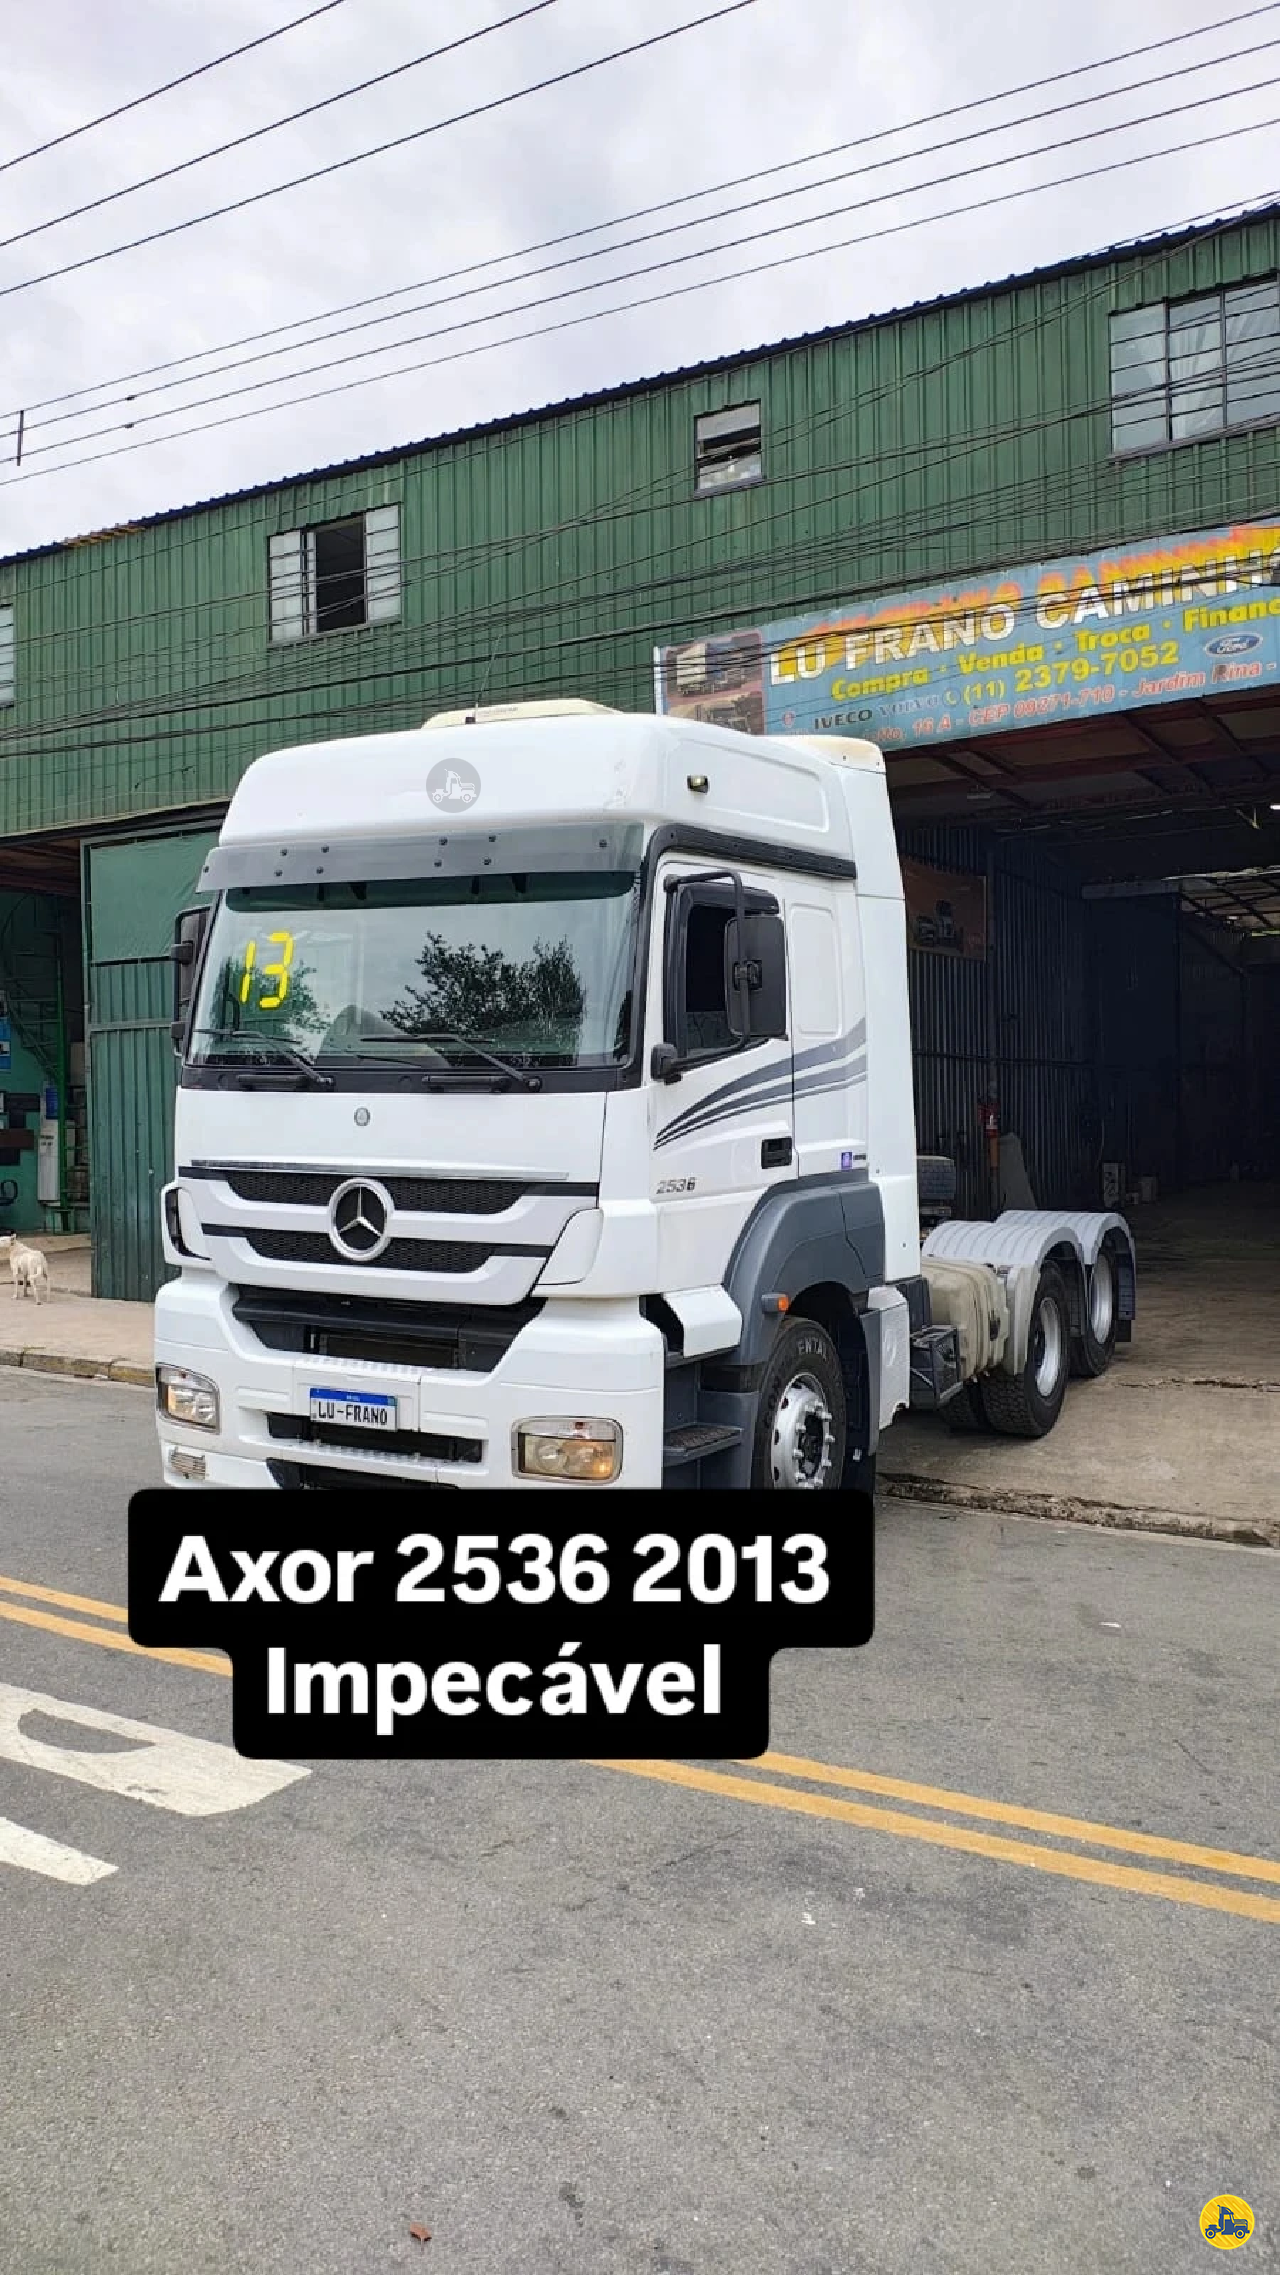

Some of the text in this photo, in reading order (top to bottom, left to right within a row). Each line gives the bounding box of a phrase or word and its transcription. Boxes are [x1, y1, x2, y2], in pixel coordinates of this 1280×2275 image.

[770, 641, 827, 685] LU
[844, 603, 1016, 671] FRANO
[831, 667, 930, 701] Compra
[958, 643, 1043, 675] Venda
[1074, 624, 1150, 653] Troca
[963, 640, 1179, 705] (11) 2379-7052
[813, 709, 873, 730] IVECO
[968, 704, 1009, 726] CEP
[241, 932, 294, 1009] 13
[656, 1177, 696, 1194] 2536
[318, 1401, 388, 1426] LU-FRANO
